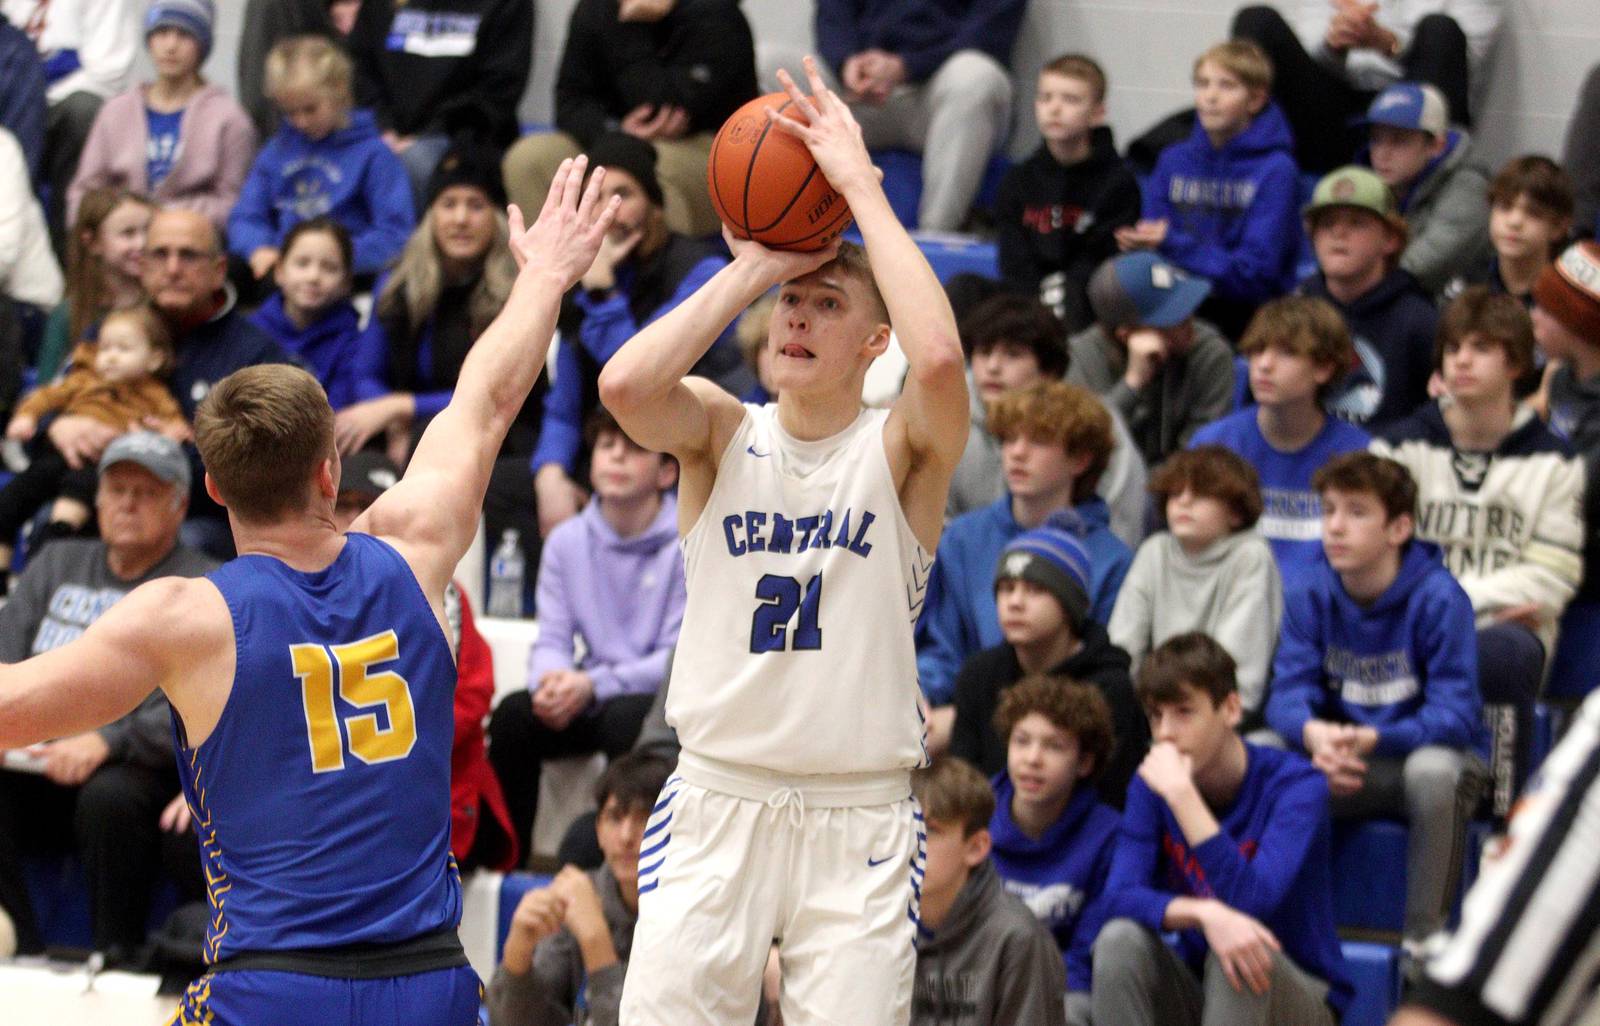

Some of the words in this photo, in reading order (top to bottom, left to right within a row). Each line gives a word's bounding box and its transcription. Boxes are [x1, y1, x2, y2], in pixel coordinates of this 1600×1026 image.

[723, 508, 876, 558] CENTRAL
[750, 568, 822, 654] 21
[289, 628, 417, 774] 15
